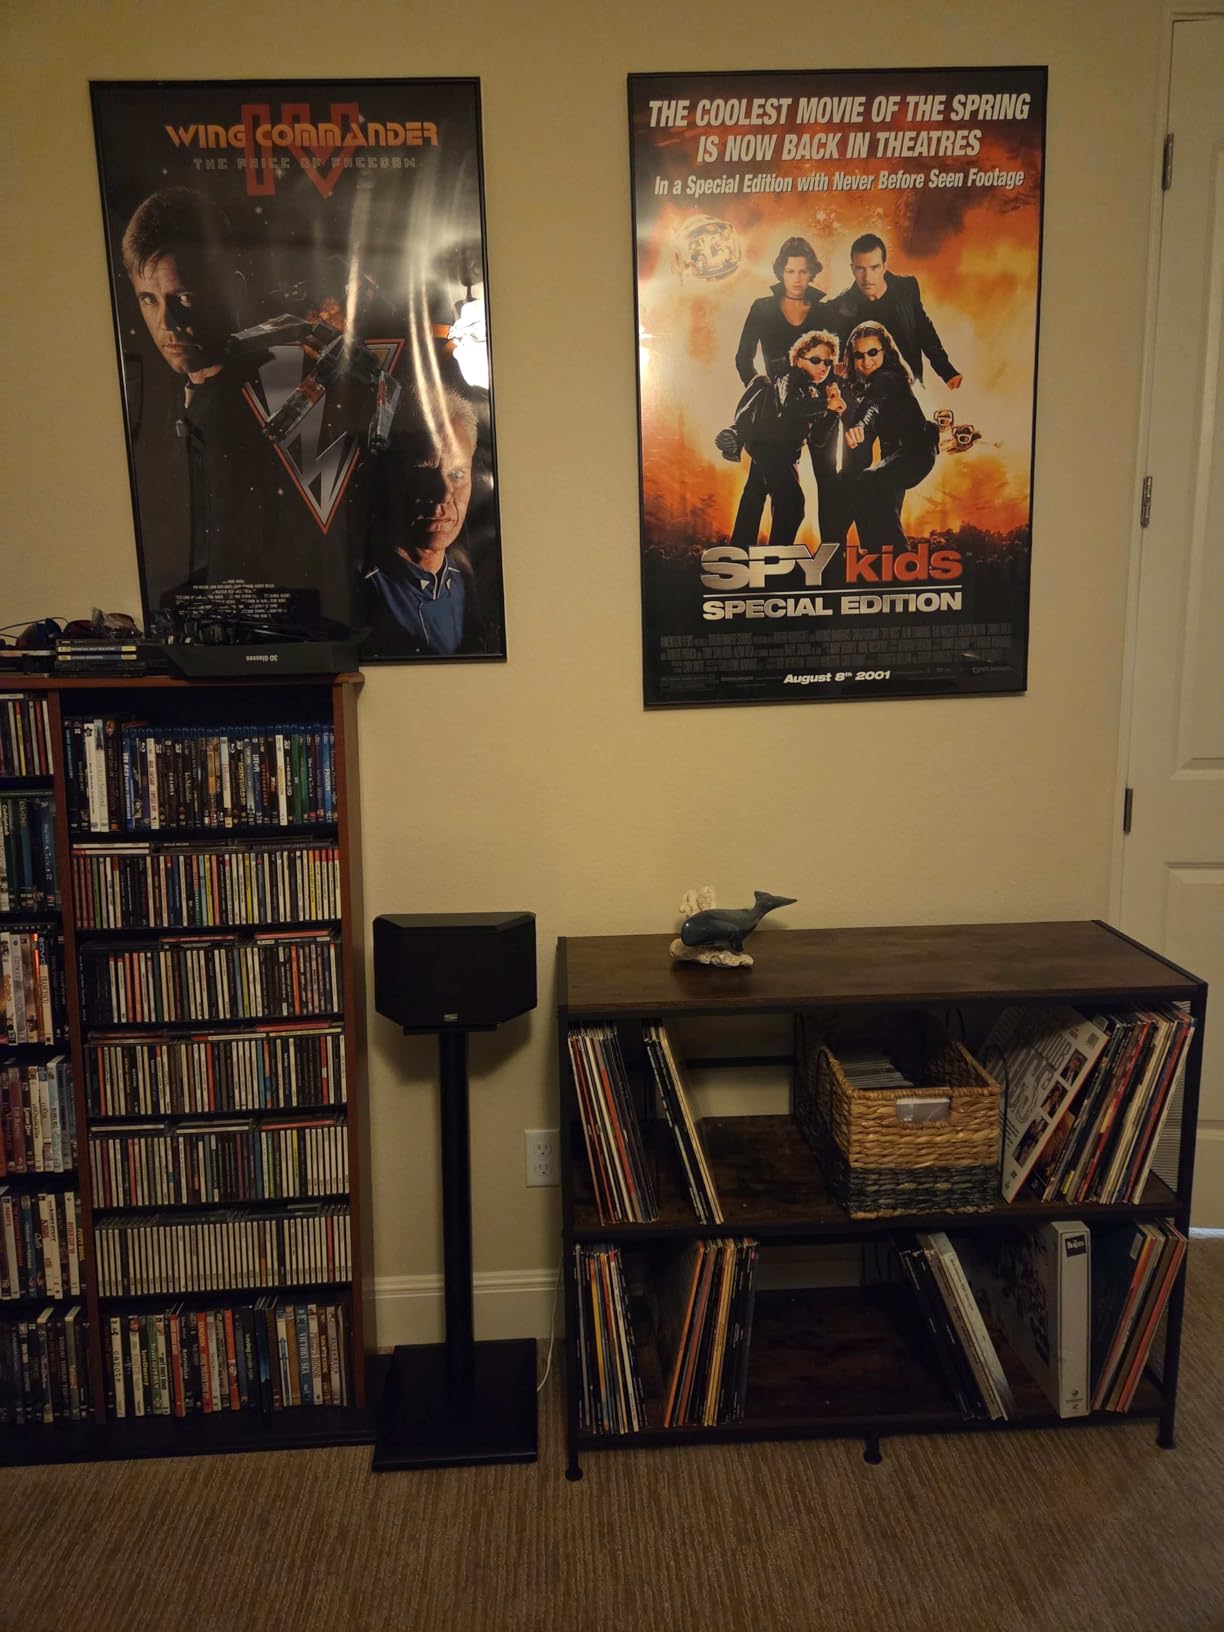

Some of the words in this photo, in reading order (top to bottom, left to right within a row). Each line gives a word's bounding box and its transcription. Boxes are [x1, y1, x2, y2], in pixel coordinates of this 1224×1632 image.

[648, 99, 689, 127] THE
[695, 98, 792, 127] COOLEST
[796, 96, 865, 124] MOVIE
[871, 96, 900, 123] OF
[906, 95, 946, 122] THE
[950, 93, 1031, 121] SPRING
[165, 124, 247, 149] WING
[256, 122, 439, 147] COMMANDER
[697, 135, 719, 163] IS
[725, 134, 779, 162] NOW
[782, 133, 841, 161] BACK
[847, 132, 870, 159] IN
[875, 130, 982, 158] THEATRES
[193, 158, 228, 170] THE
[237, 157, 291, 170] PRICE
[299, 157, 321, 169] OF
[332, 157, 417, 169] FREEDOM
[655, 175, 669, 195] In
[672, 180, 682, 195] a
[686, 174, 738, 198] Special
[743, 173, 792, 194] Edition
[797, 172, 829, 192] with
[832, 171, 874, 192] Never
[878, 170, 925, 190] Before
[928, 169, 964, 188] Seen
[967, 169, 1024, 190] Footage
[700, 542, 840, 590] SPY
[845, 543, 963, 584] kids
[703, 597, 833, 621] SPECIAL
[841, 591, 962, 615] EDITION
[784, 672, 832, 685] August
[855, 670, 891, 681] 2001
